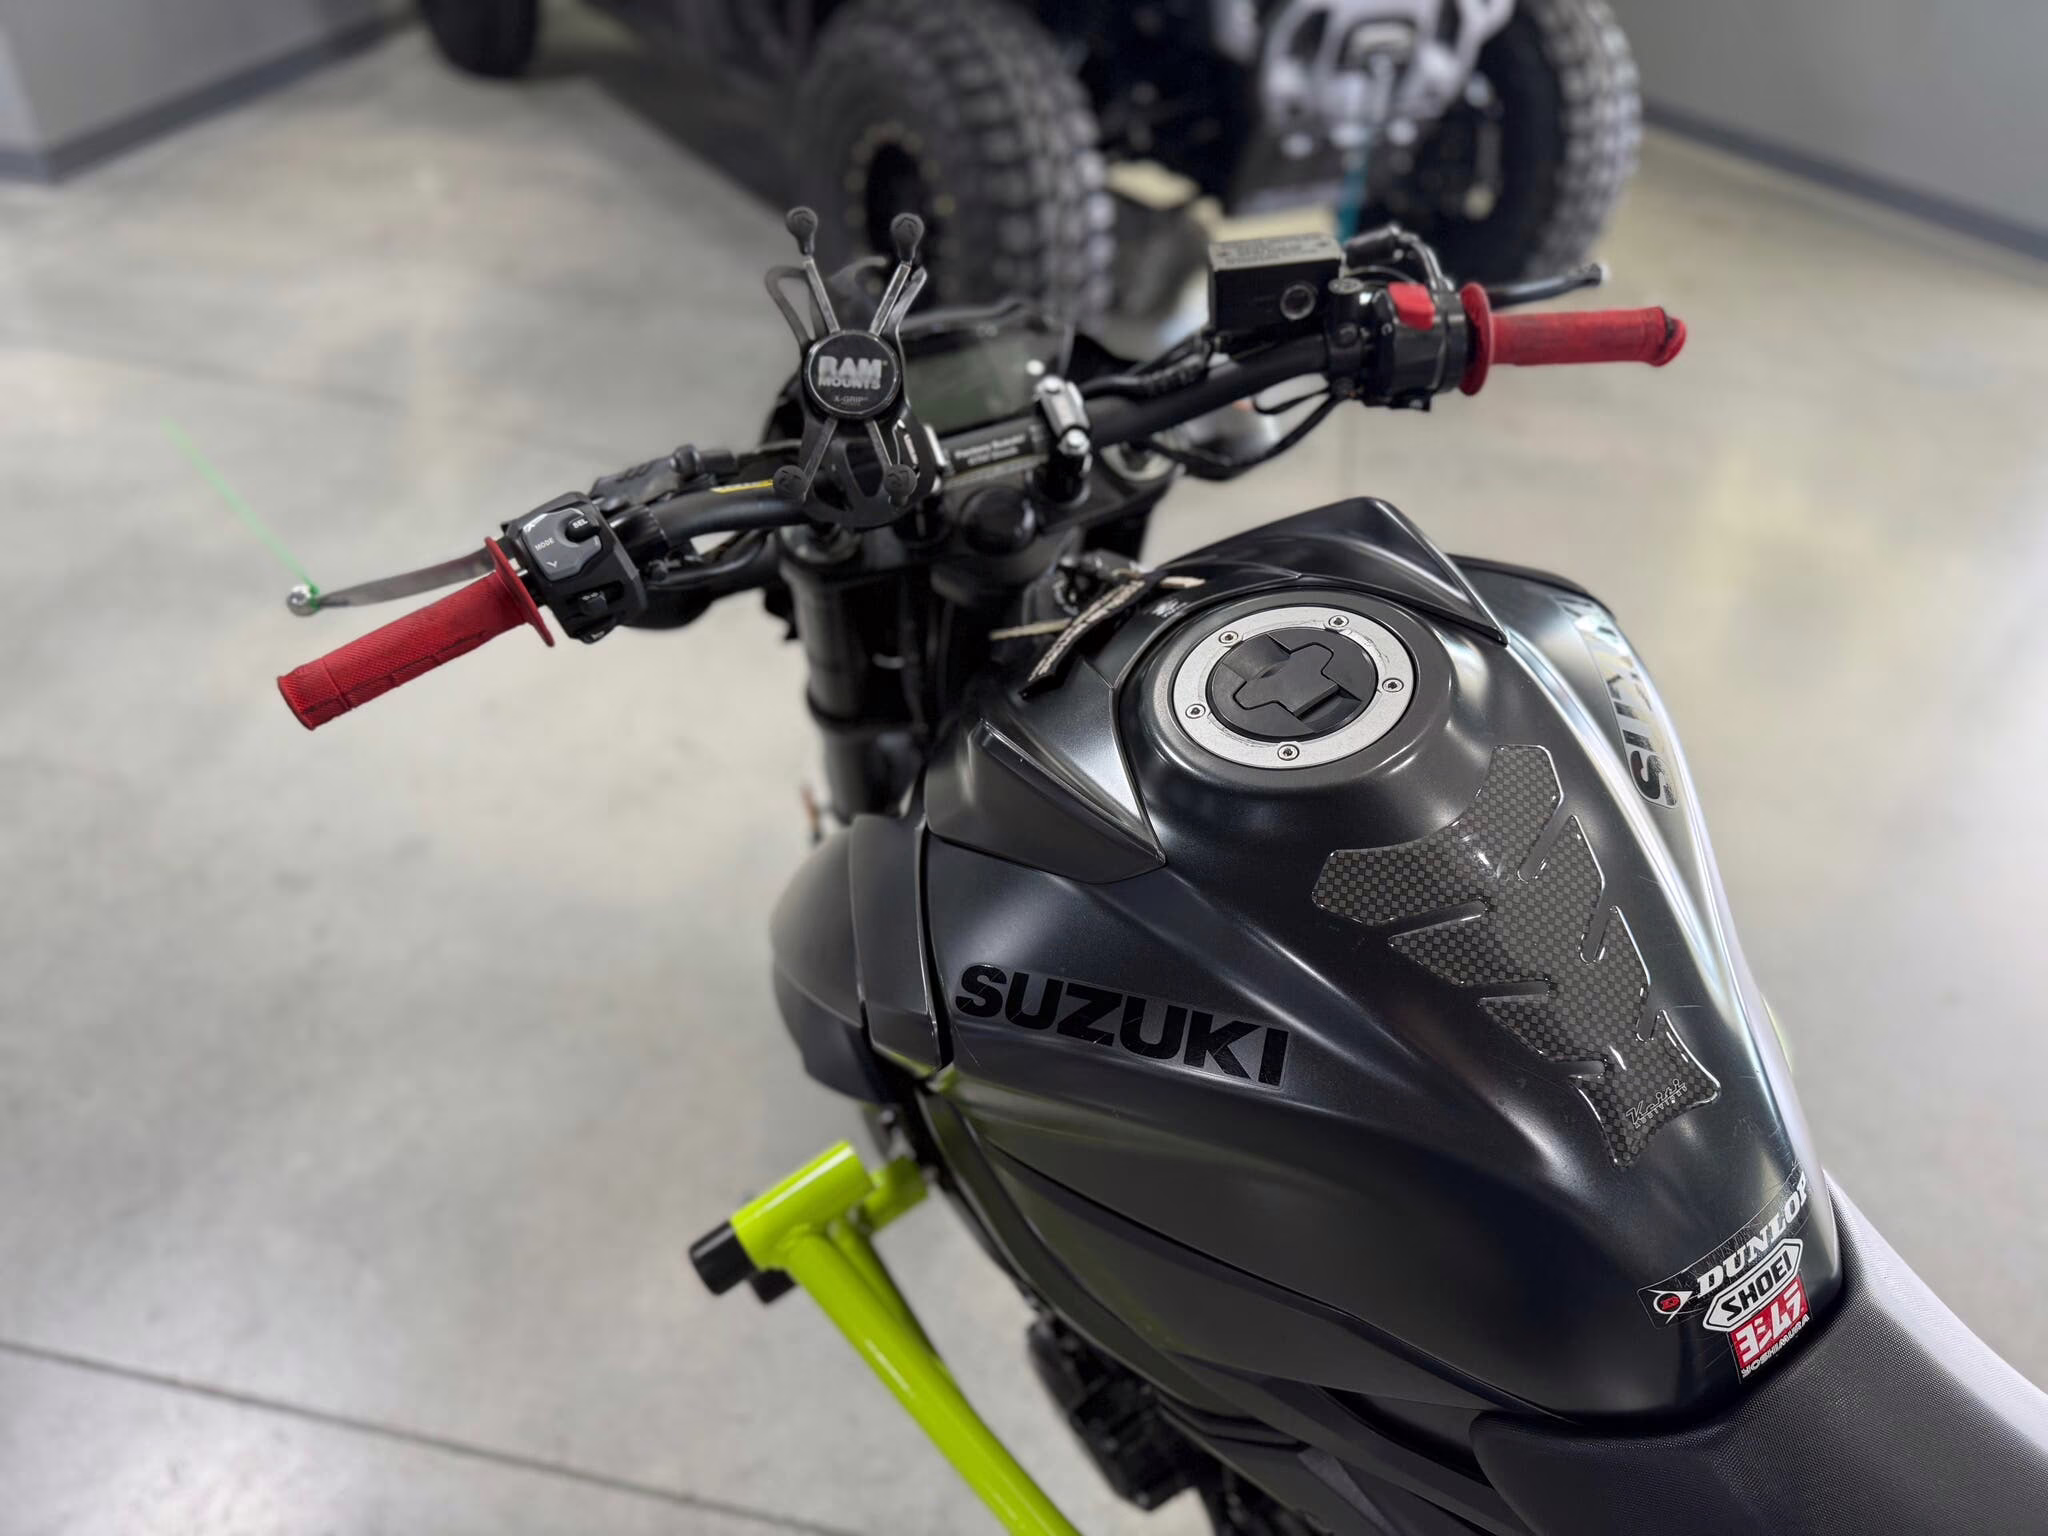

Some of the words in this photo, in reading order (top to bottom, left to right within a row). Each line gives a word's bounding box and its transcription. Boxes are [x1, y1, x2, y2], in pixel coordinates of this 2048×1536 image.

[818, 356, 881, 379] RAM
[818, 376, 881, 390] MOUNTS
[534, 537, 555, 551] MODE
[571, 518, 588, 529] SEL
[955, 964, 1290, 1087] SUZUKI
[1696, 1171, 1808, 1299] DUNLOP
[1721, 1250, 1792, 1322] SHOEI
[1740, 1313, 1810, 1379] YOSHIMURA
